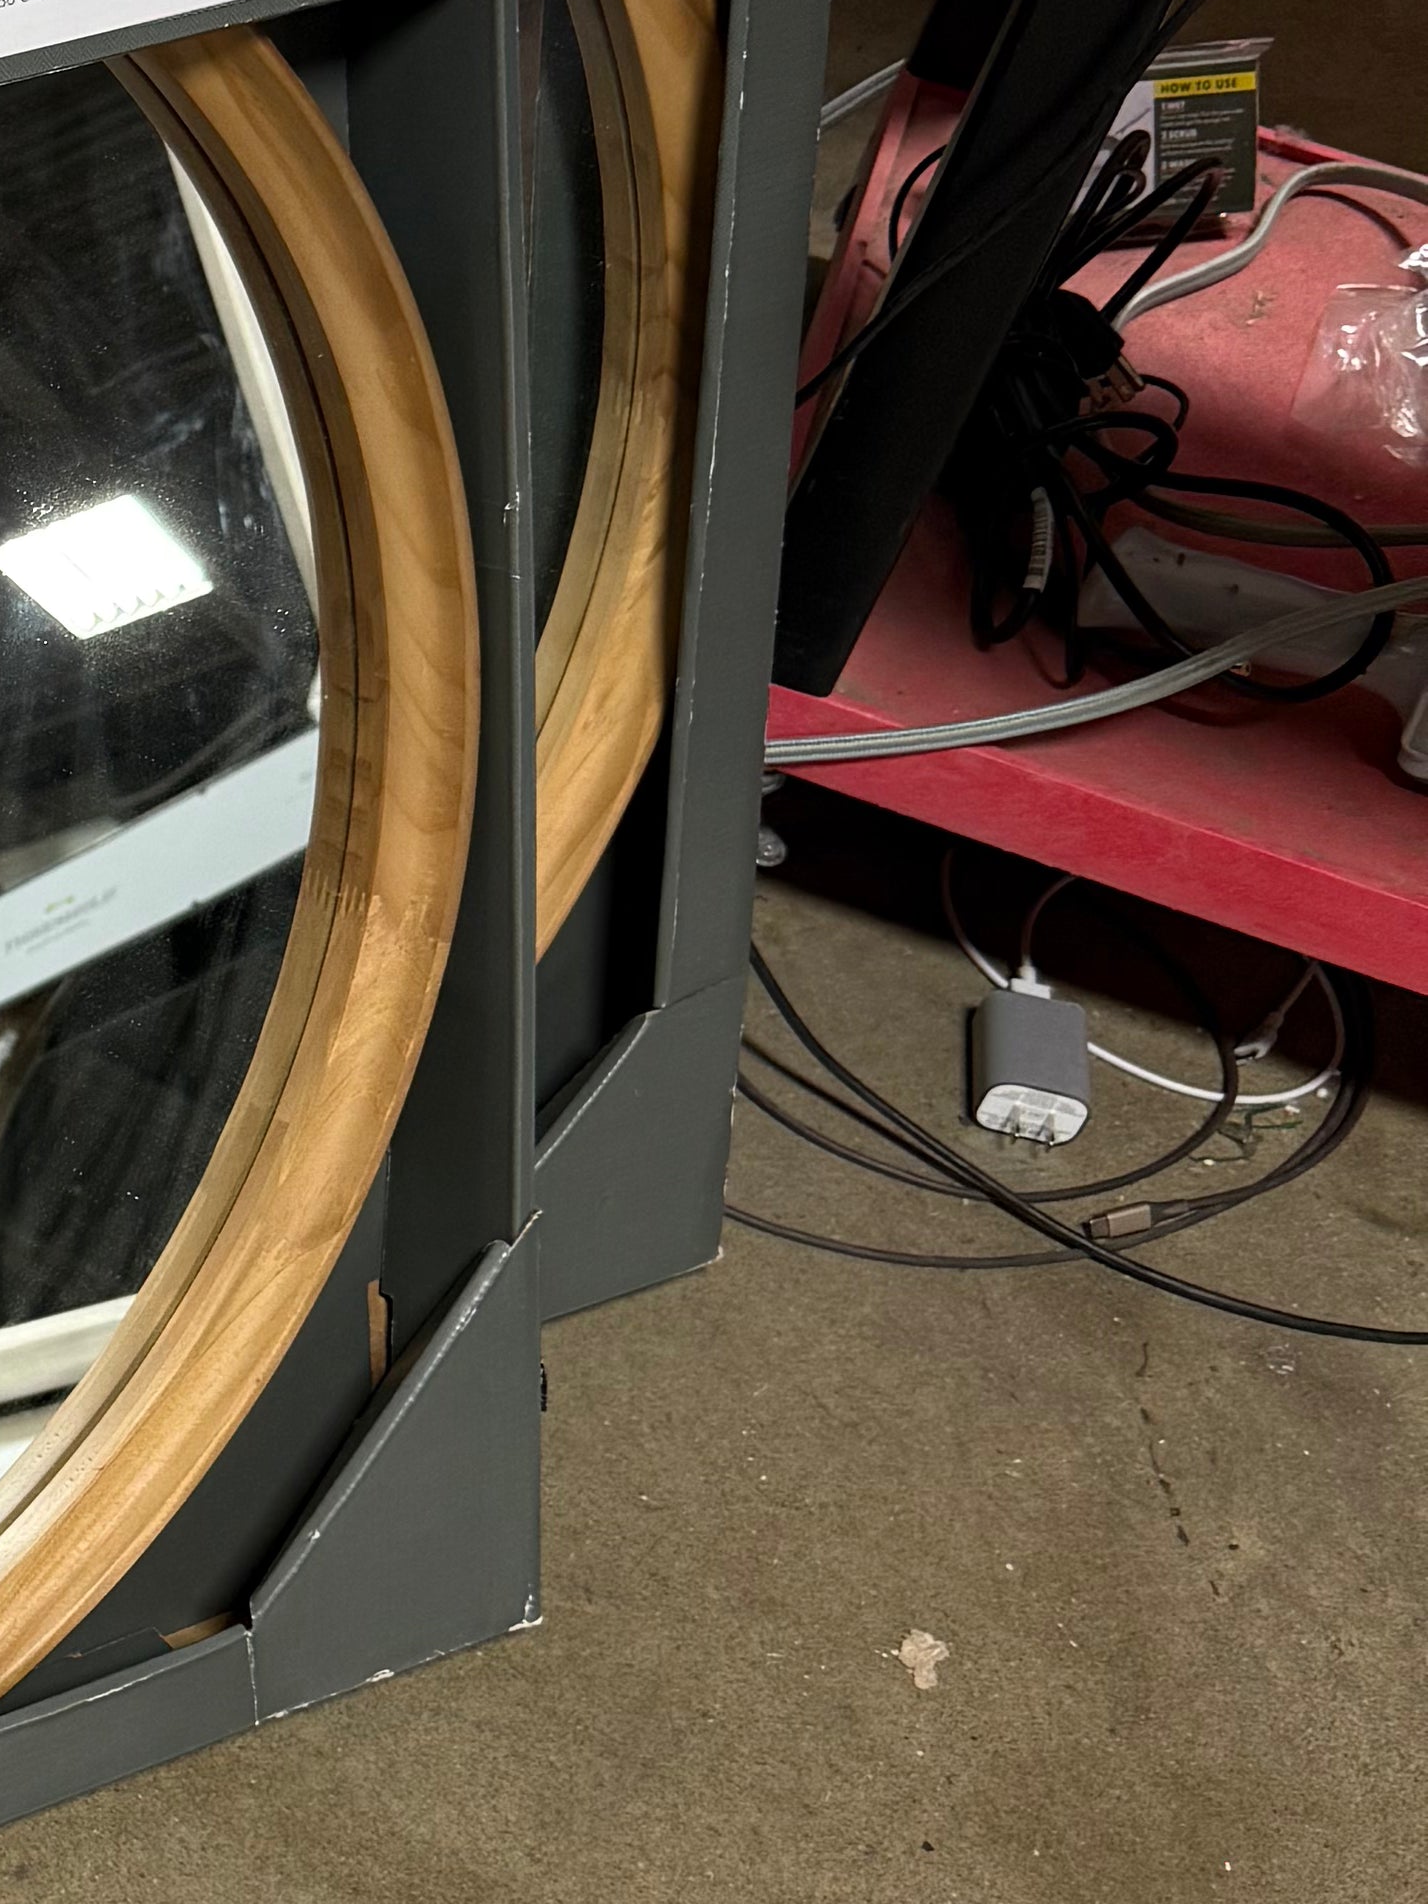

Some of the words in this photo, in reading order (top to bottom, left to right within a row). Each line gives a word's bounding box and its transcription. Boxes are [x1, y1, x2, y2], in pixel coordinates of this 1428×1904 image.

[1160, 82, 1191, 94] HOW
[1195, 79, 1211, 91] TO
[1215, 77, 1237, 89] USE
